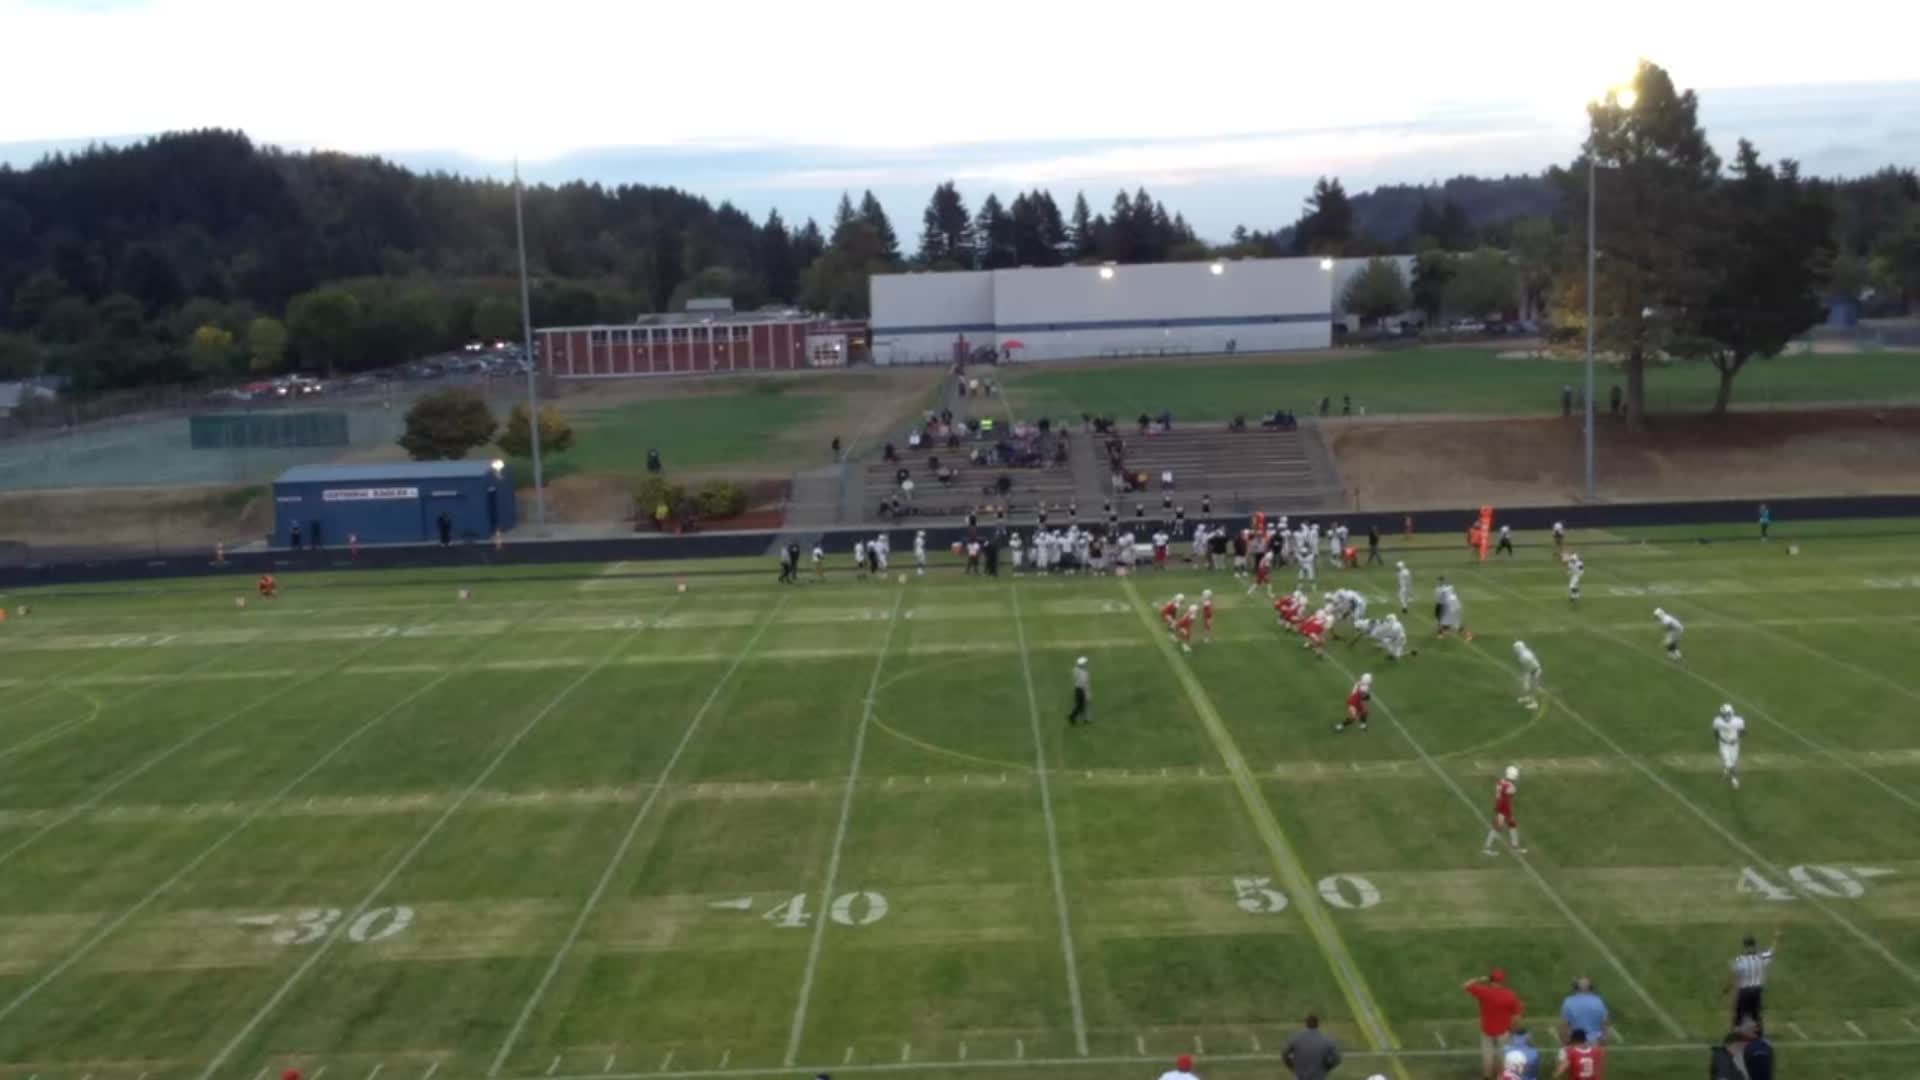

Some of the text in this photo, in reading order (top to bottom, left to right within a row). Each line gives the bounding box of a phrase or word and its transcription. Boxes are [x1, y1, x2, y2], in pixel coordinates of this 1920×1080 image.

[1232, 873, 1381, 912] 50
[1735, 864, 1865, 901] 40
[761, 891, 889, 928] 40
[1579, 1057, 1594, 1078] 3
